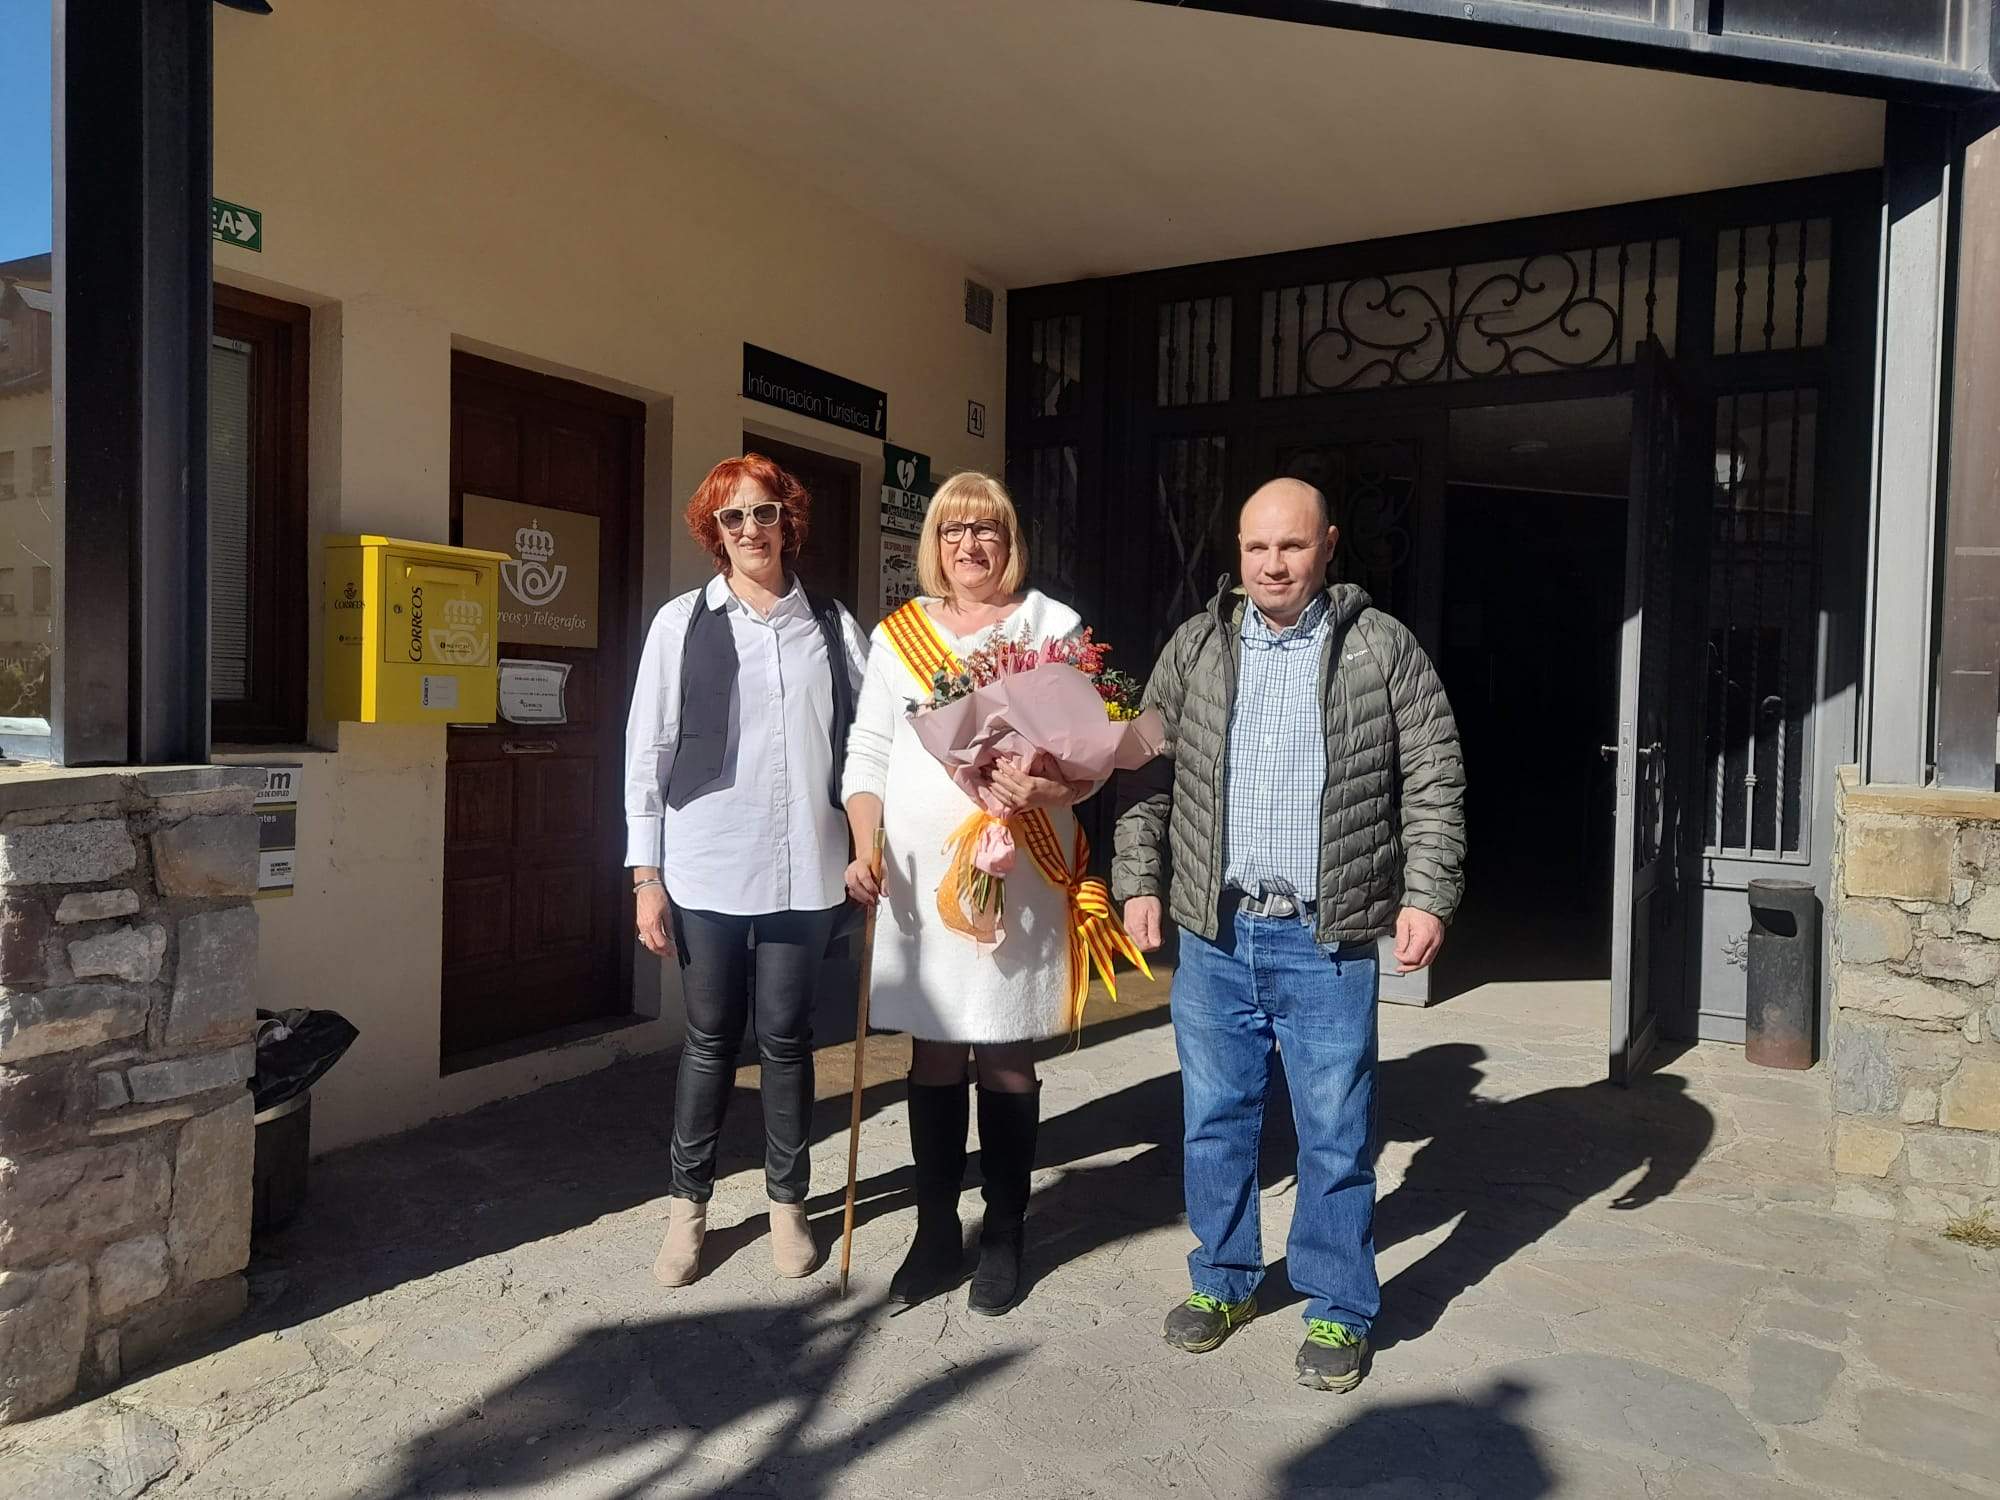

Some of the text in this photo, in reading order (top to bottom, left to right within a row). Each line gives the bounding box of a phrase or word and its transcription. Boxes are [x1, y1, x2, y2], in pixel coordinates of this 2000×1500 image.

[747, 370, 822, 417] Información
[825, 397, 870, 429] Turística
[903, 492, 923, 512] DEA
[408, 586, 423, 661] CORREOS
[533, 610, 587, 632] Telégrafos
